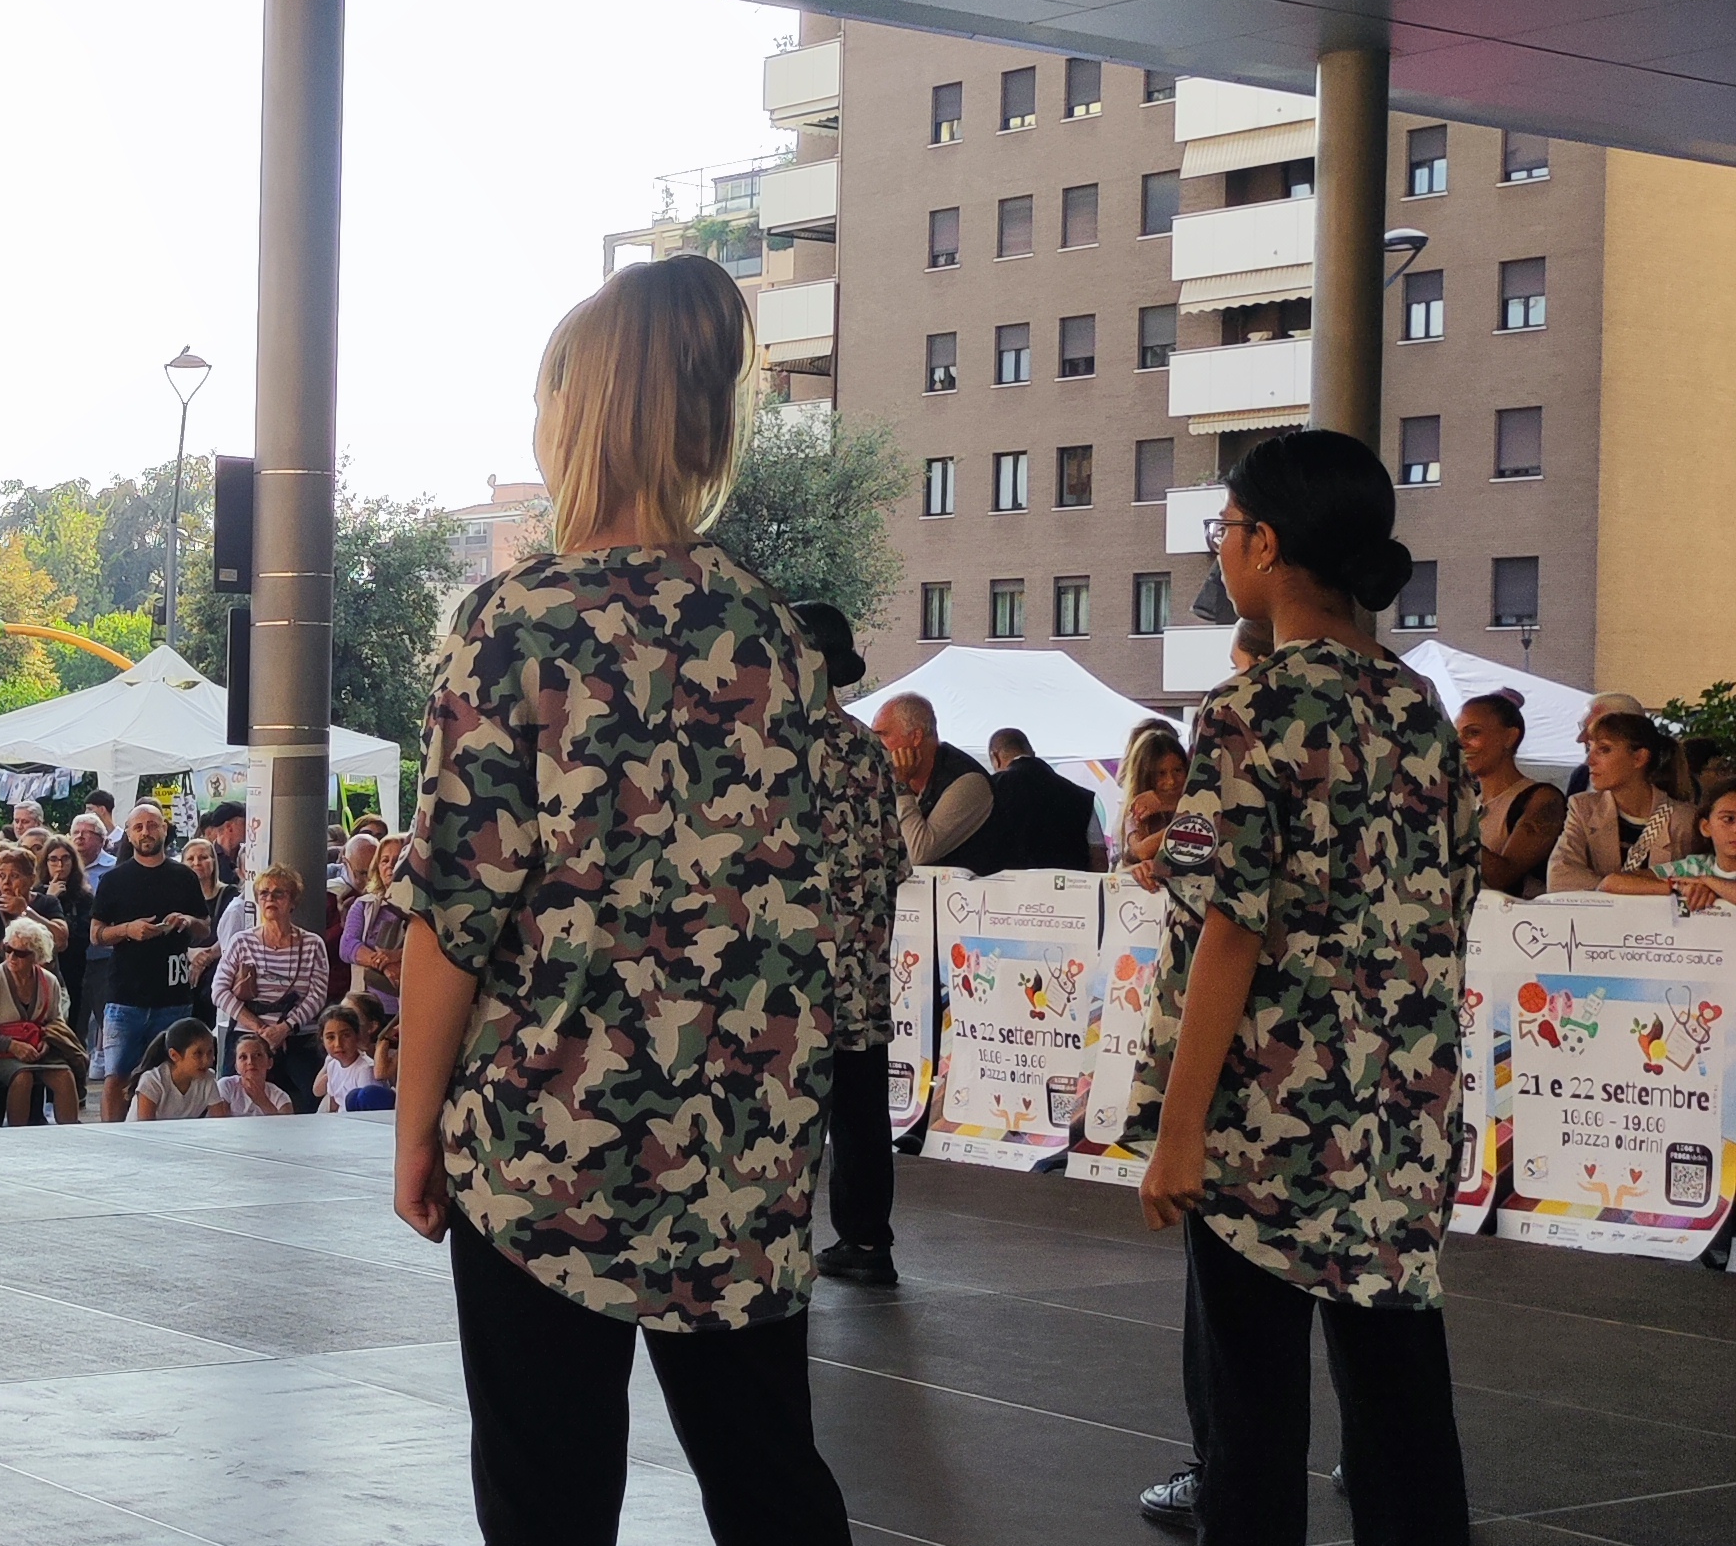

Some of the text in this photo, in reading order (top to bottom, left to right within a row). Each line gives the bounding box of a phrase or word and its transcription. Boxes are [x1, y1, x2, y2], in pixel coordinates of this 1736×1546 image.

[998, 1025, 1082, 1050] settembre
[1102, 1033, 1122, 1055] 21
[1517, 1072, 1544, 1096] 21
[1550, 1078, 1563, 1098] e
[1569, 1076, 1595, 1100] 22
[1600, 1080, 1710, 1112] settembre
[1561, 1108, 1604, 1127] 10.00
[1622, 1114, 1665, 1134] 19.00
[1561, 1129, 1610, 1149] piazza
